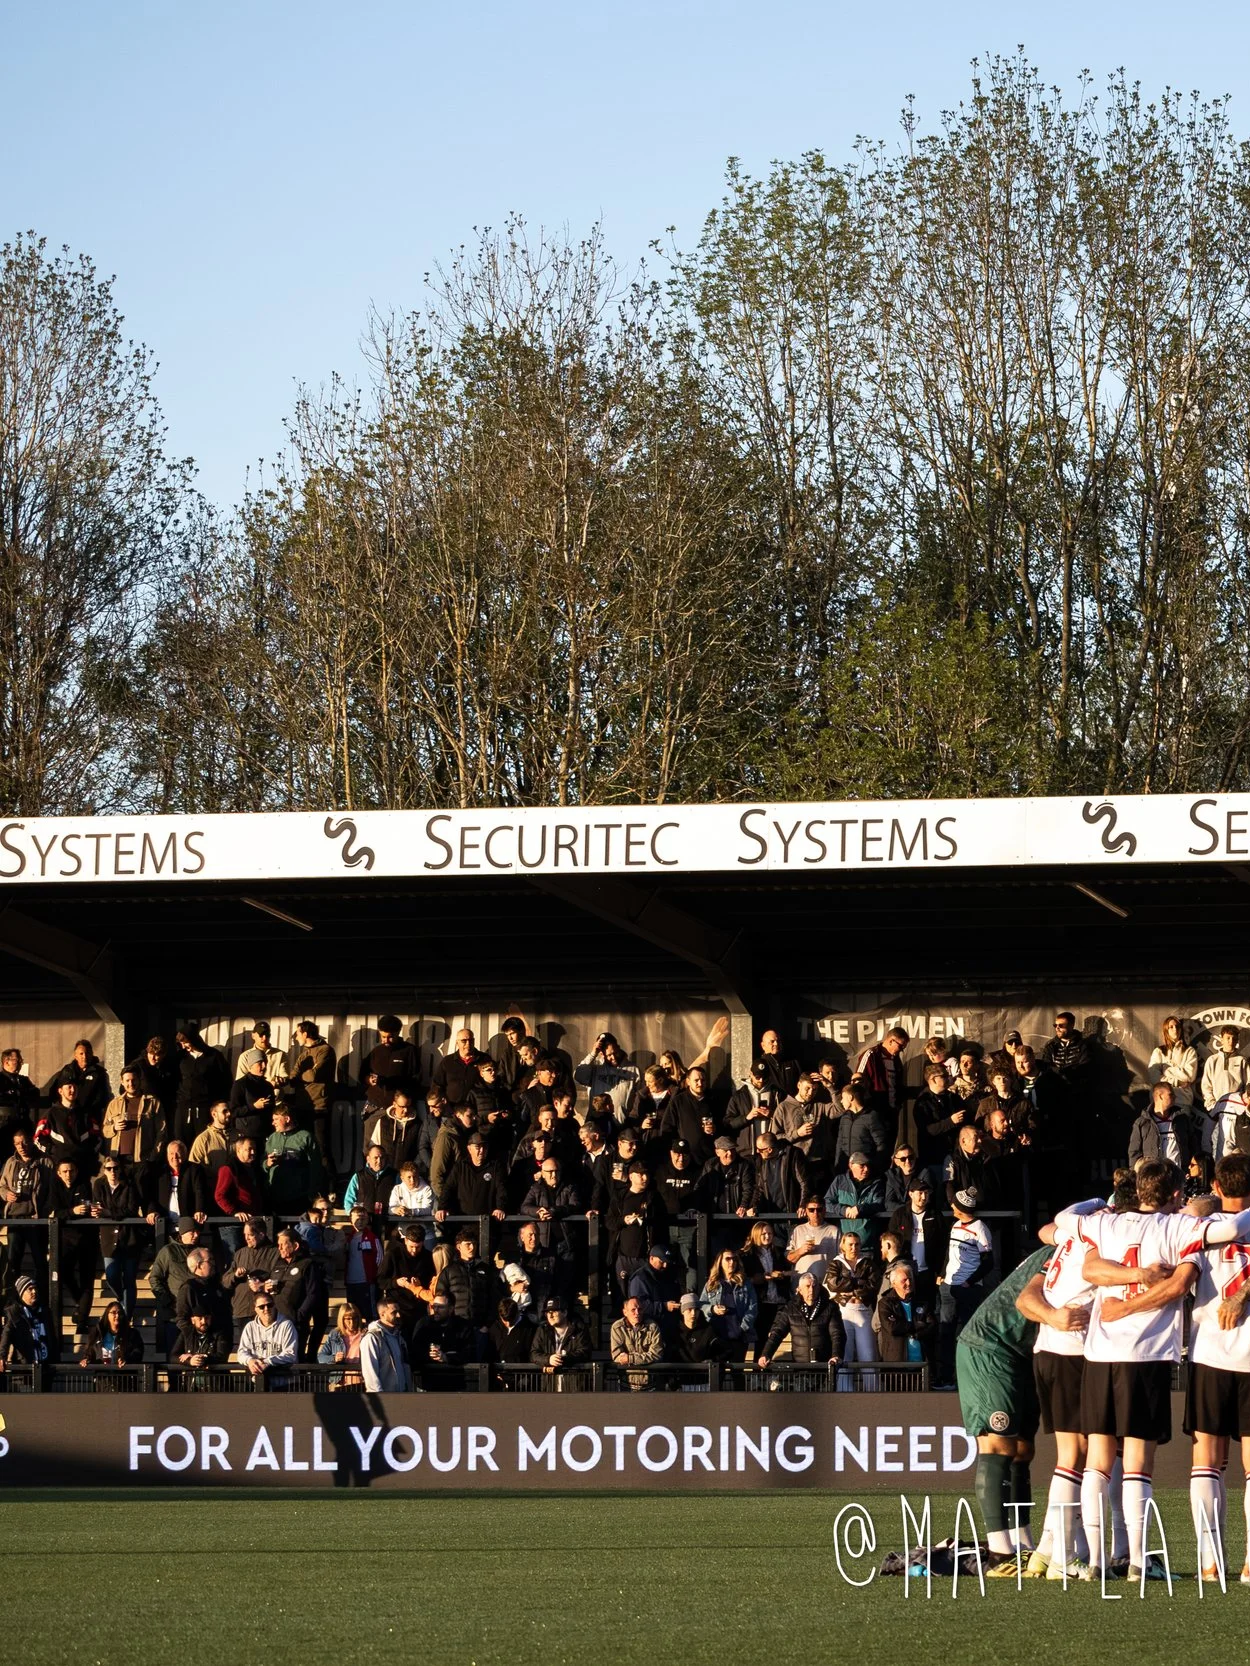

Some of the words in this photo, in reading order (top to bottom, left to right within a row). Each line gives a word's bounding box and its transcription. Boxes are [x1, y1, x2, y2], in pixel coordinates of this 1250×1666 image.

[0, 823, 204, 877] SYSTEMS
[424, 815, 680, 869] SECURITEC
[738, 809, 958, 864] SYSTEMS
[797, 1018, 851, 1044] THE
[856, 1016, 965, 1043] PITMEN
[129, 1425, 233, 1471] FOR
[245, 1425, 338, 1471] ALL
[349, 1425, 500, 1472] YOUR
[518, 1425, 815, 1472] MOTORING
